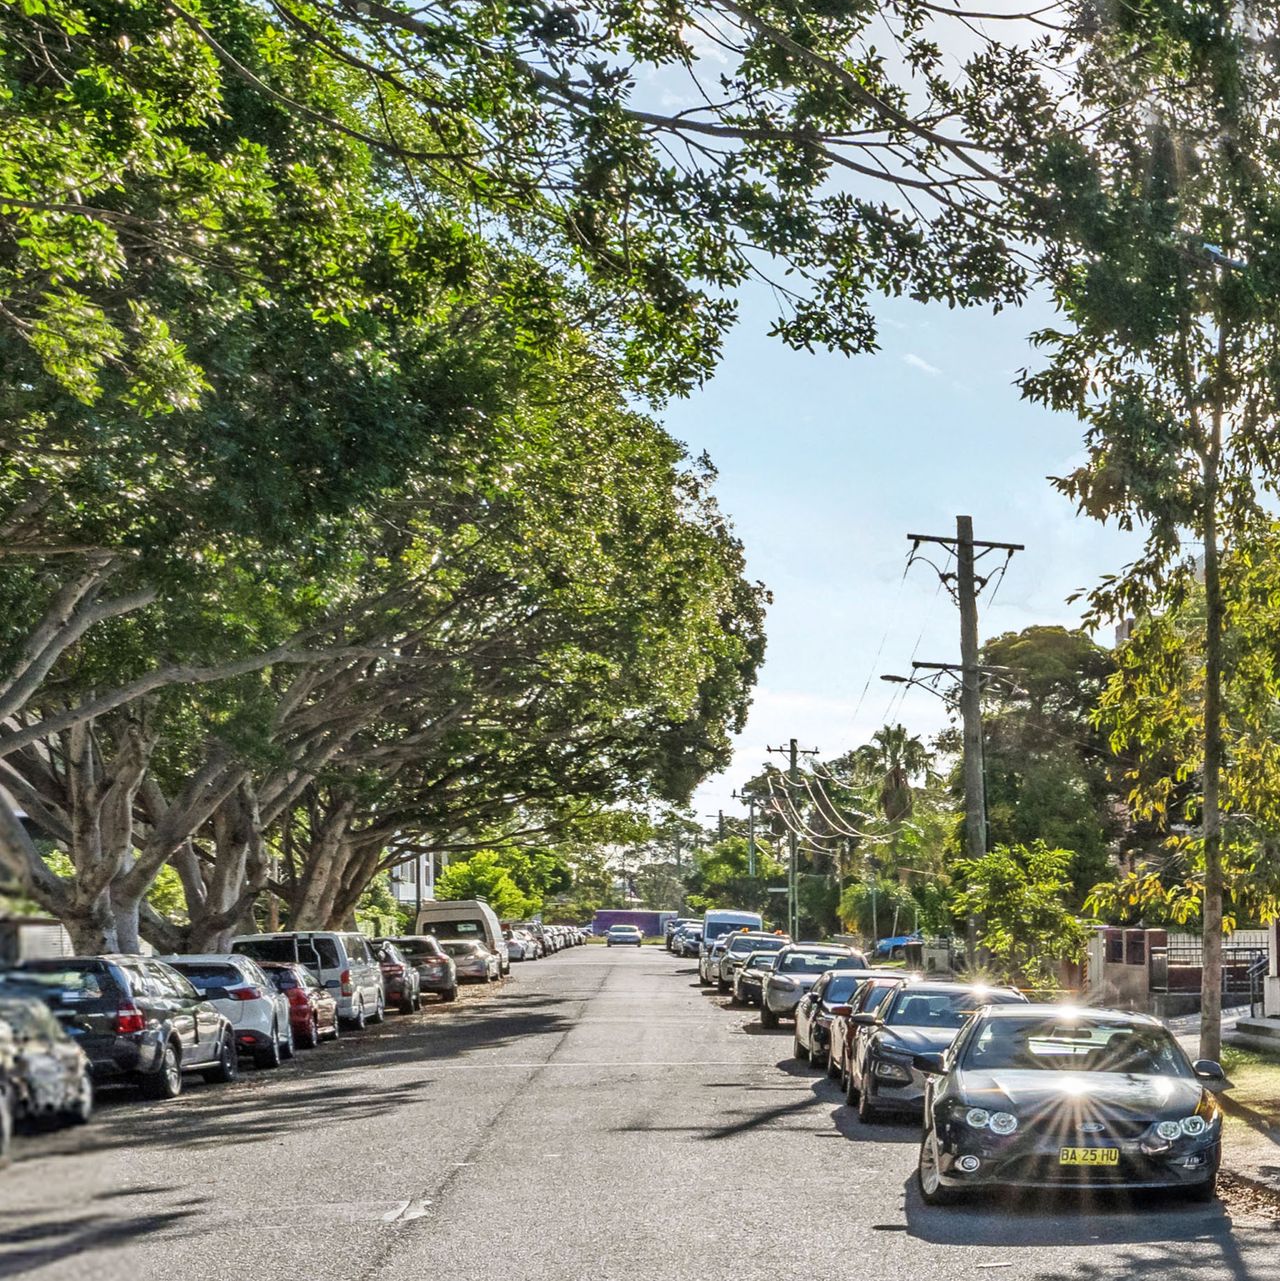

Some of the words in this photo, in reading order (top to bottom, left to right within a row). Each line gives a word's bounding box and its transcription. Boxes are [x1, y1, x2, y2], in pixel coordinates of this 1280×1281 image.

[1061, 1149, 1077, 1161] BA
[1081, 1149, 1098, 1161] 25
[1101, 1149, 1117, 1161] HU
